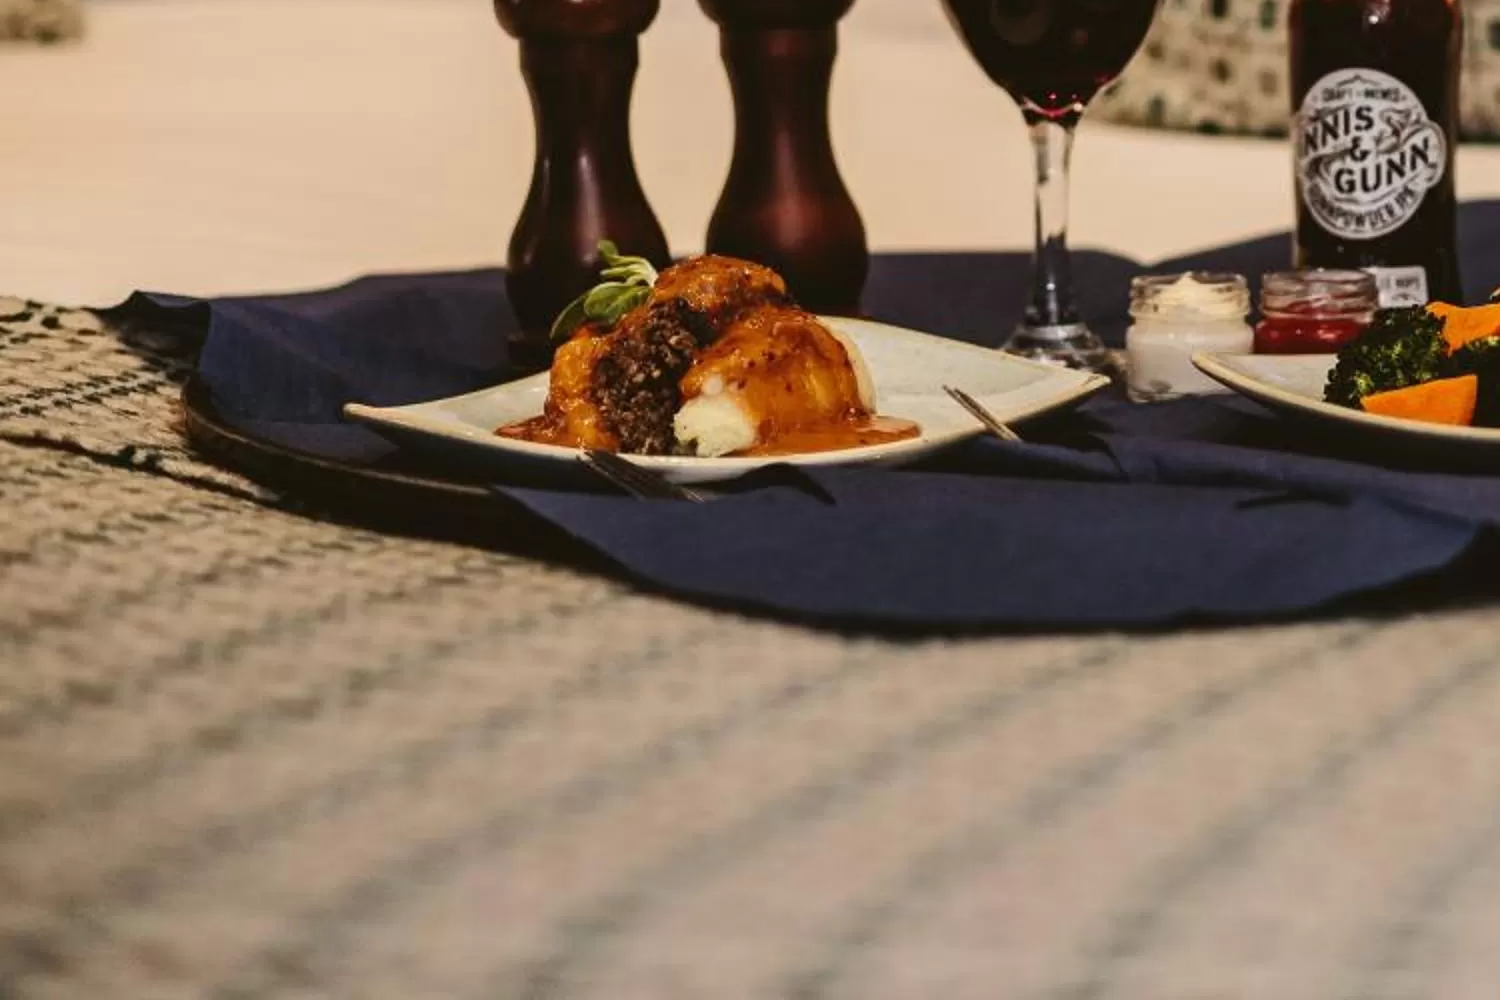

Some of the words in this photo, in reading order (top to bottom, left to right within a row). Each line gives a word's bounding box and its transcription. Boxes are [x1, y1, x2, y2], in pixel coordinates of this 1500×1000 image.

[1301, 105, 1375, 156] NNIS
[1351, 136, 1370, 161] &
[1334, 137, 1429, 193] GUNN
